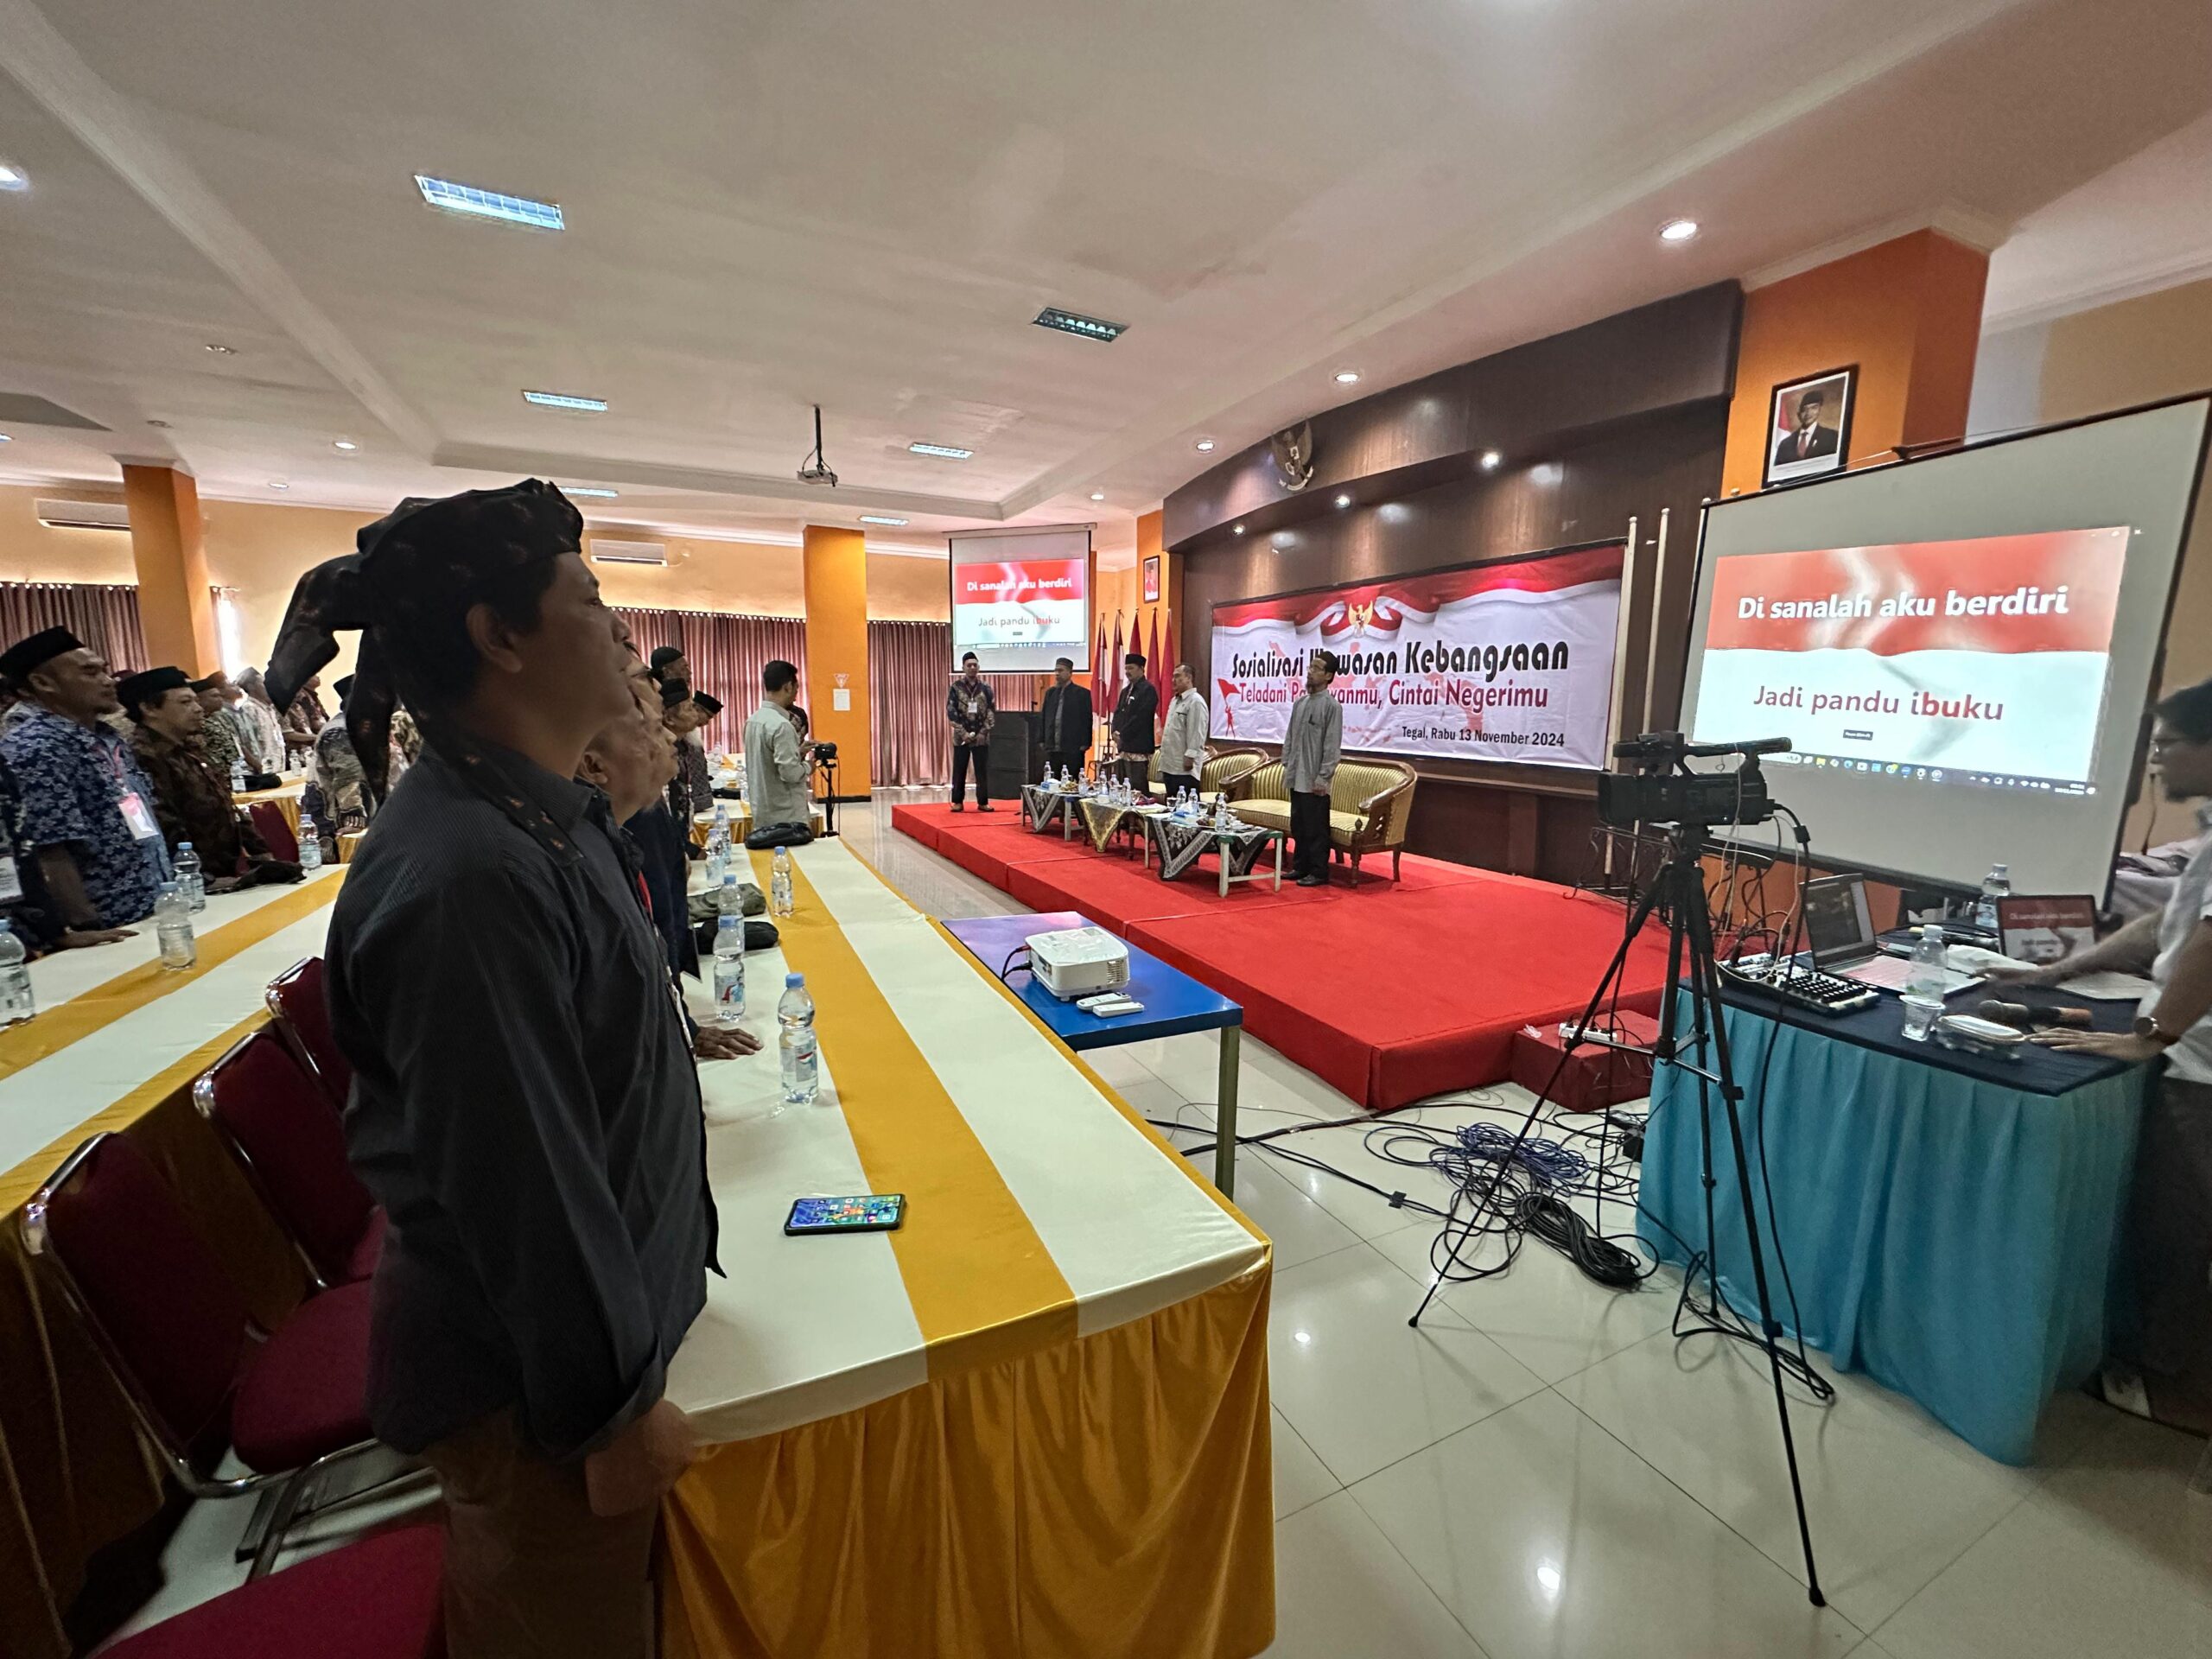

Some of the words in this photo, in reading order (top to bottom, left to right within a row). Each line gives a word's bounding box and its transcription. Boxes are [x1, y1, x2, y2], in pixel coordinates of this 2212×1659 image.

[967, 582, 978, 591] Di
[1039, 577, 1072, 588] berdiri
[1738, 596, 1764, 619] Di
[1770, 594, 1872, 619] sanalah
[1878, 591, 1936, 617] aku
[1944, 585, 2069, 617] berdiri
[978, 617, 997, 627] Jadi
[1000, 616, 1030, 628] pandu
[1232, 648, 1303, 678] Sosialisasi
[1309, 648, 1397, 677] wasan
[1405, 640, 1568, 683] Kebangsaan
[1239, 682, 1287, 703] Teladani
[1291, 681, 1382, 709] Panmu,
[1389, 679, 1439, 706] Cintai
[1445, 679, 1548, 713] Negerimu
[1753, 685, 1803, 708] Jadi
[1811, 690, 1899, 715] pandu
[1910, 690, 2004, 721] ibuku
[1402, 726, 1427, 741] Tegal,
[1431, 728, 1456, 741] Rabu
[1459, 728, 1471, 741] 13
[1474, 729, 1529, 745] November
[1531, 732, 1565, 747] 2024
